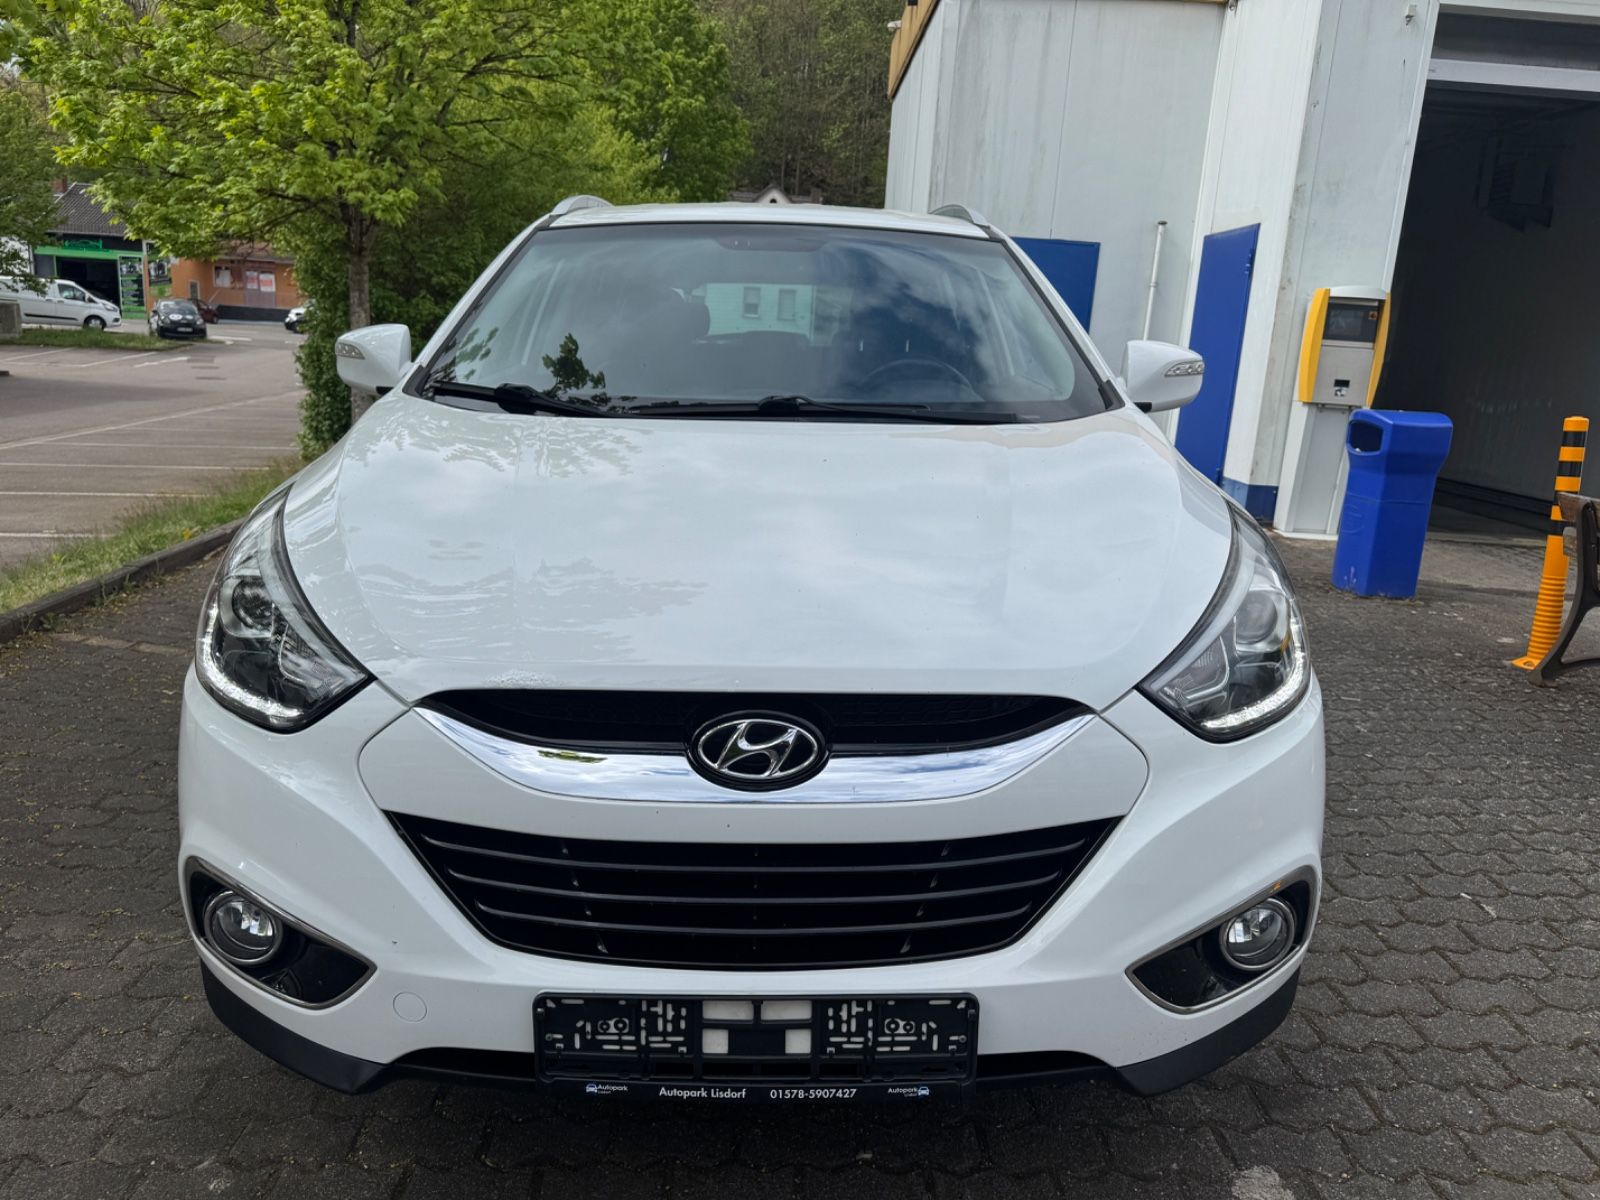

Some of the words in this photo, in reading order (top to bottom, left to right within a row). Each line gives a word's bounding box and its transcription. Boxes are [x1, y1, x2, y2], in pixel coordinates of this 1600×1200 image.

[597, 1084, 629, 1092] Autopark
[658, 1086, 708, 1100] Autopark
[711, 1087, 747, 1099] Lisdorf
[769, 1088, 858, 1099] 01578-5907427
